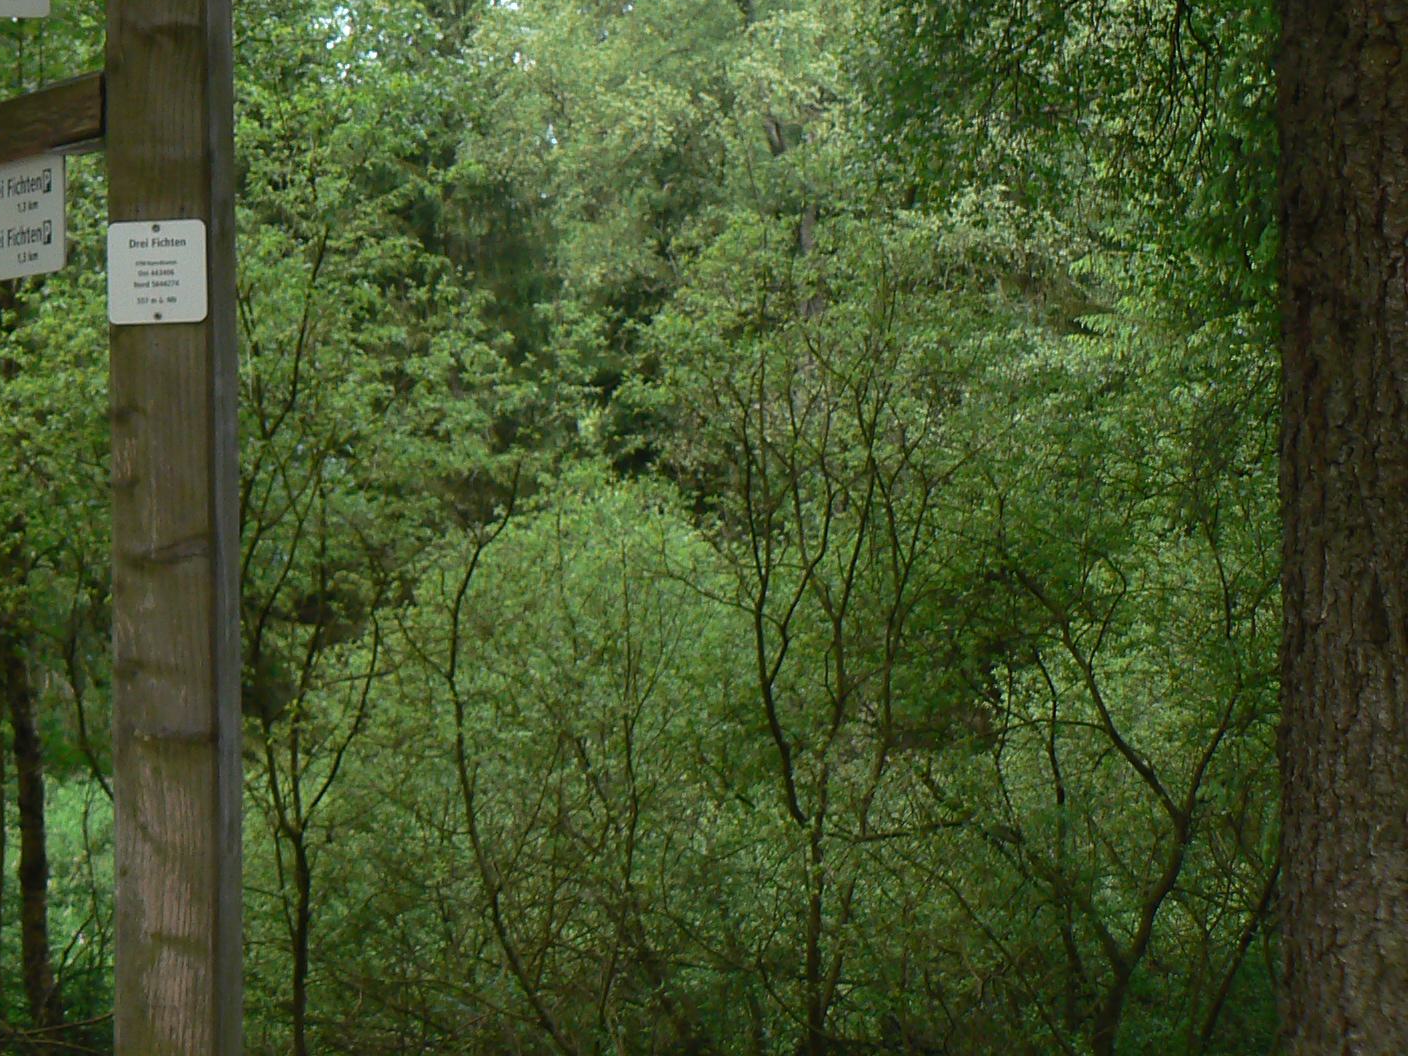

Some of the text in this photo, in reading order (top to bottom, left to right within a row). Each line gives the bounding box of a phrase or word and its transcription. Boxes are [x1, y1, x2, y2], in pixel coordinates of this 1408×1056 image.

[7, 174, 42, 198] Fichten
[7, 225, 42, 248] Fichten
[130, 237, 186, 249] Drei Fichten
